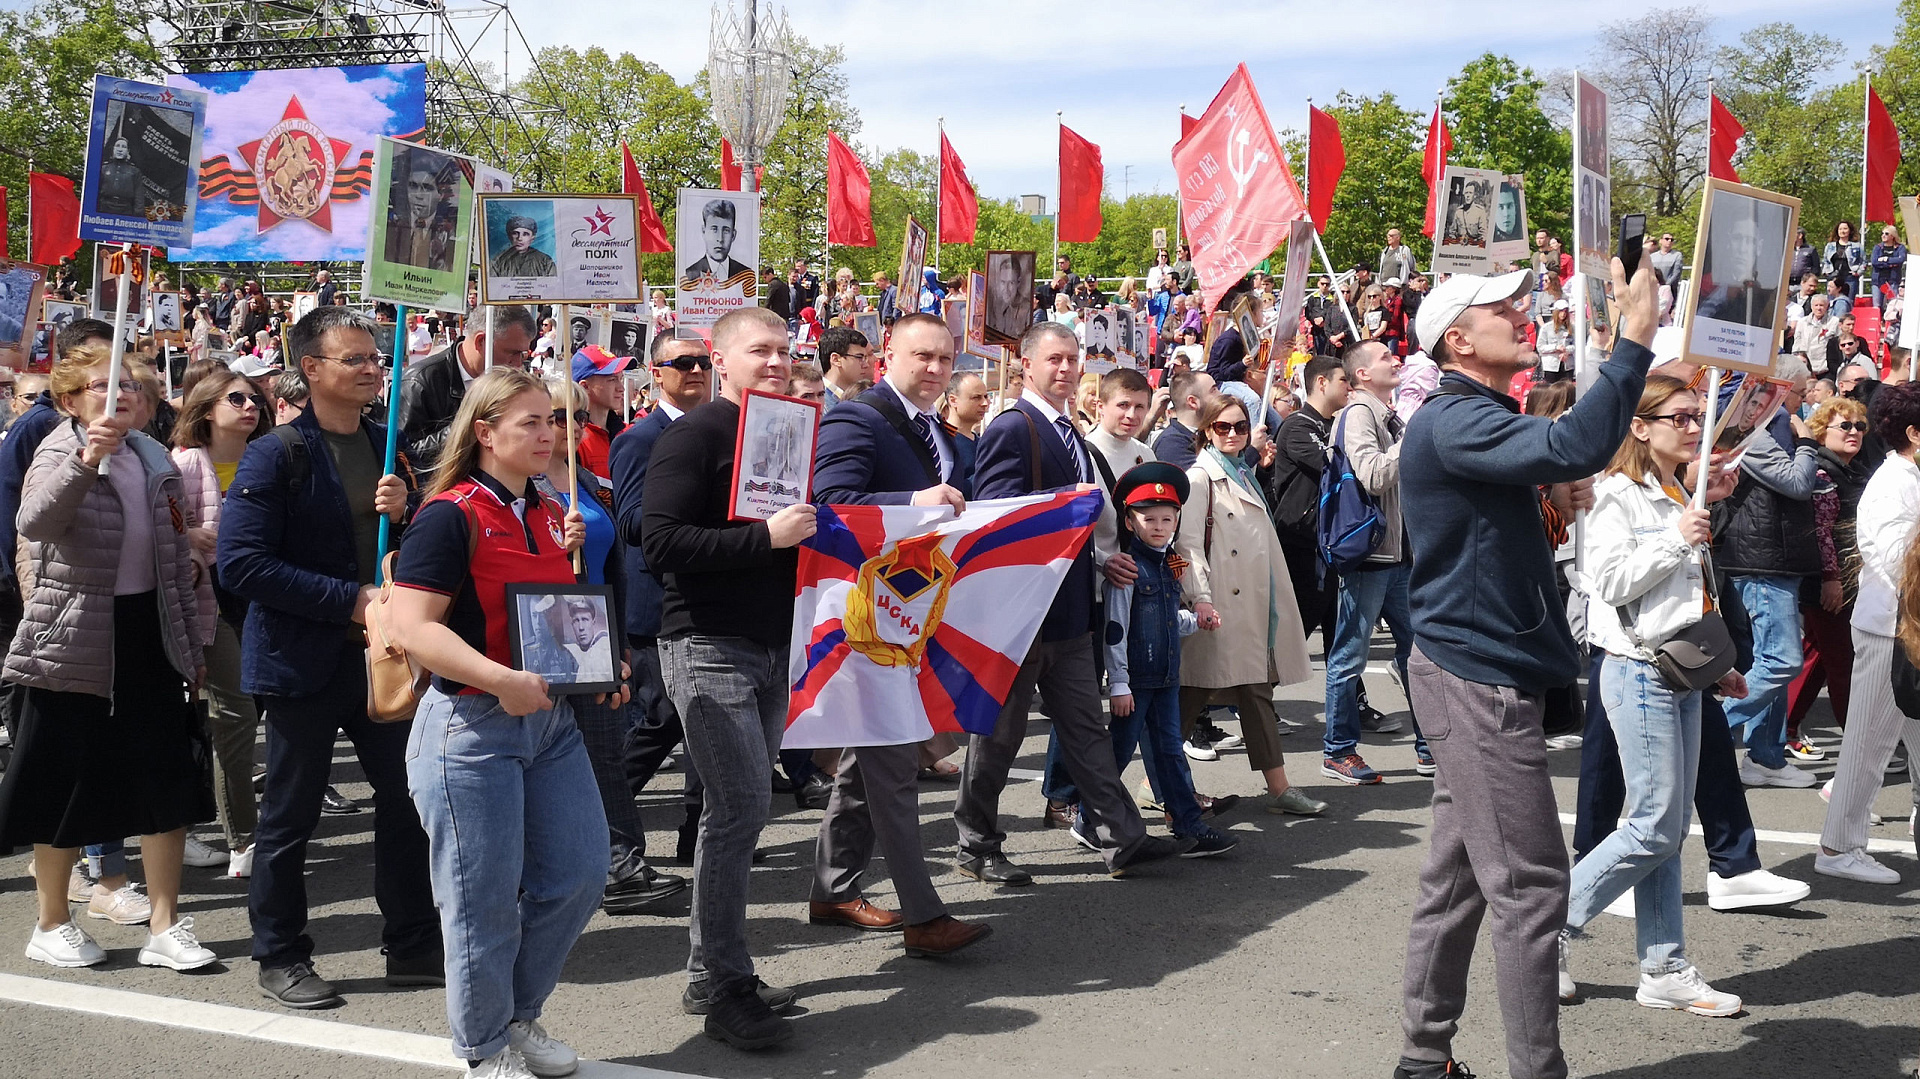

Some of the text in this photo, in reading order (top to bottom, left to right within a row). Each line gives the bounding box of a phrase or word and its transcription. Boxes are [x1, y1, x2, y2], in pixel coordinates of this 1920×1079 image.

[256, 119, 335, 188] БЕССМЕРТНЫЙ ПОЛК РОССИИ
[83, 214, 114, 226] Любаев
[115, 218, 148, 230] Алексей
[403, 271, 432, 284] Ильин
[384, 280, 403, 290] Иван
[404, 283, 448, 296] Маркелович
[692, 297, 743, 306] ТРИФОНОВ
[682, 306, 738, 316] Иван Серге
[1725, 339, 1755, 347] НИКОЛАЕИЧ
[877, 595, 920, 636] ЦСКА
